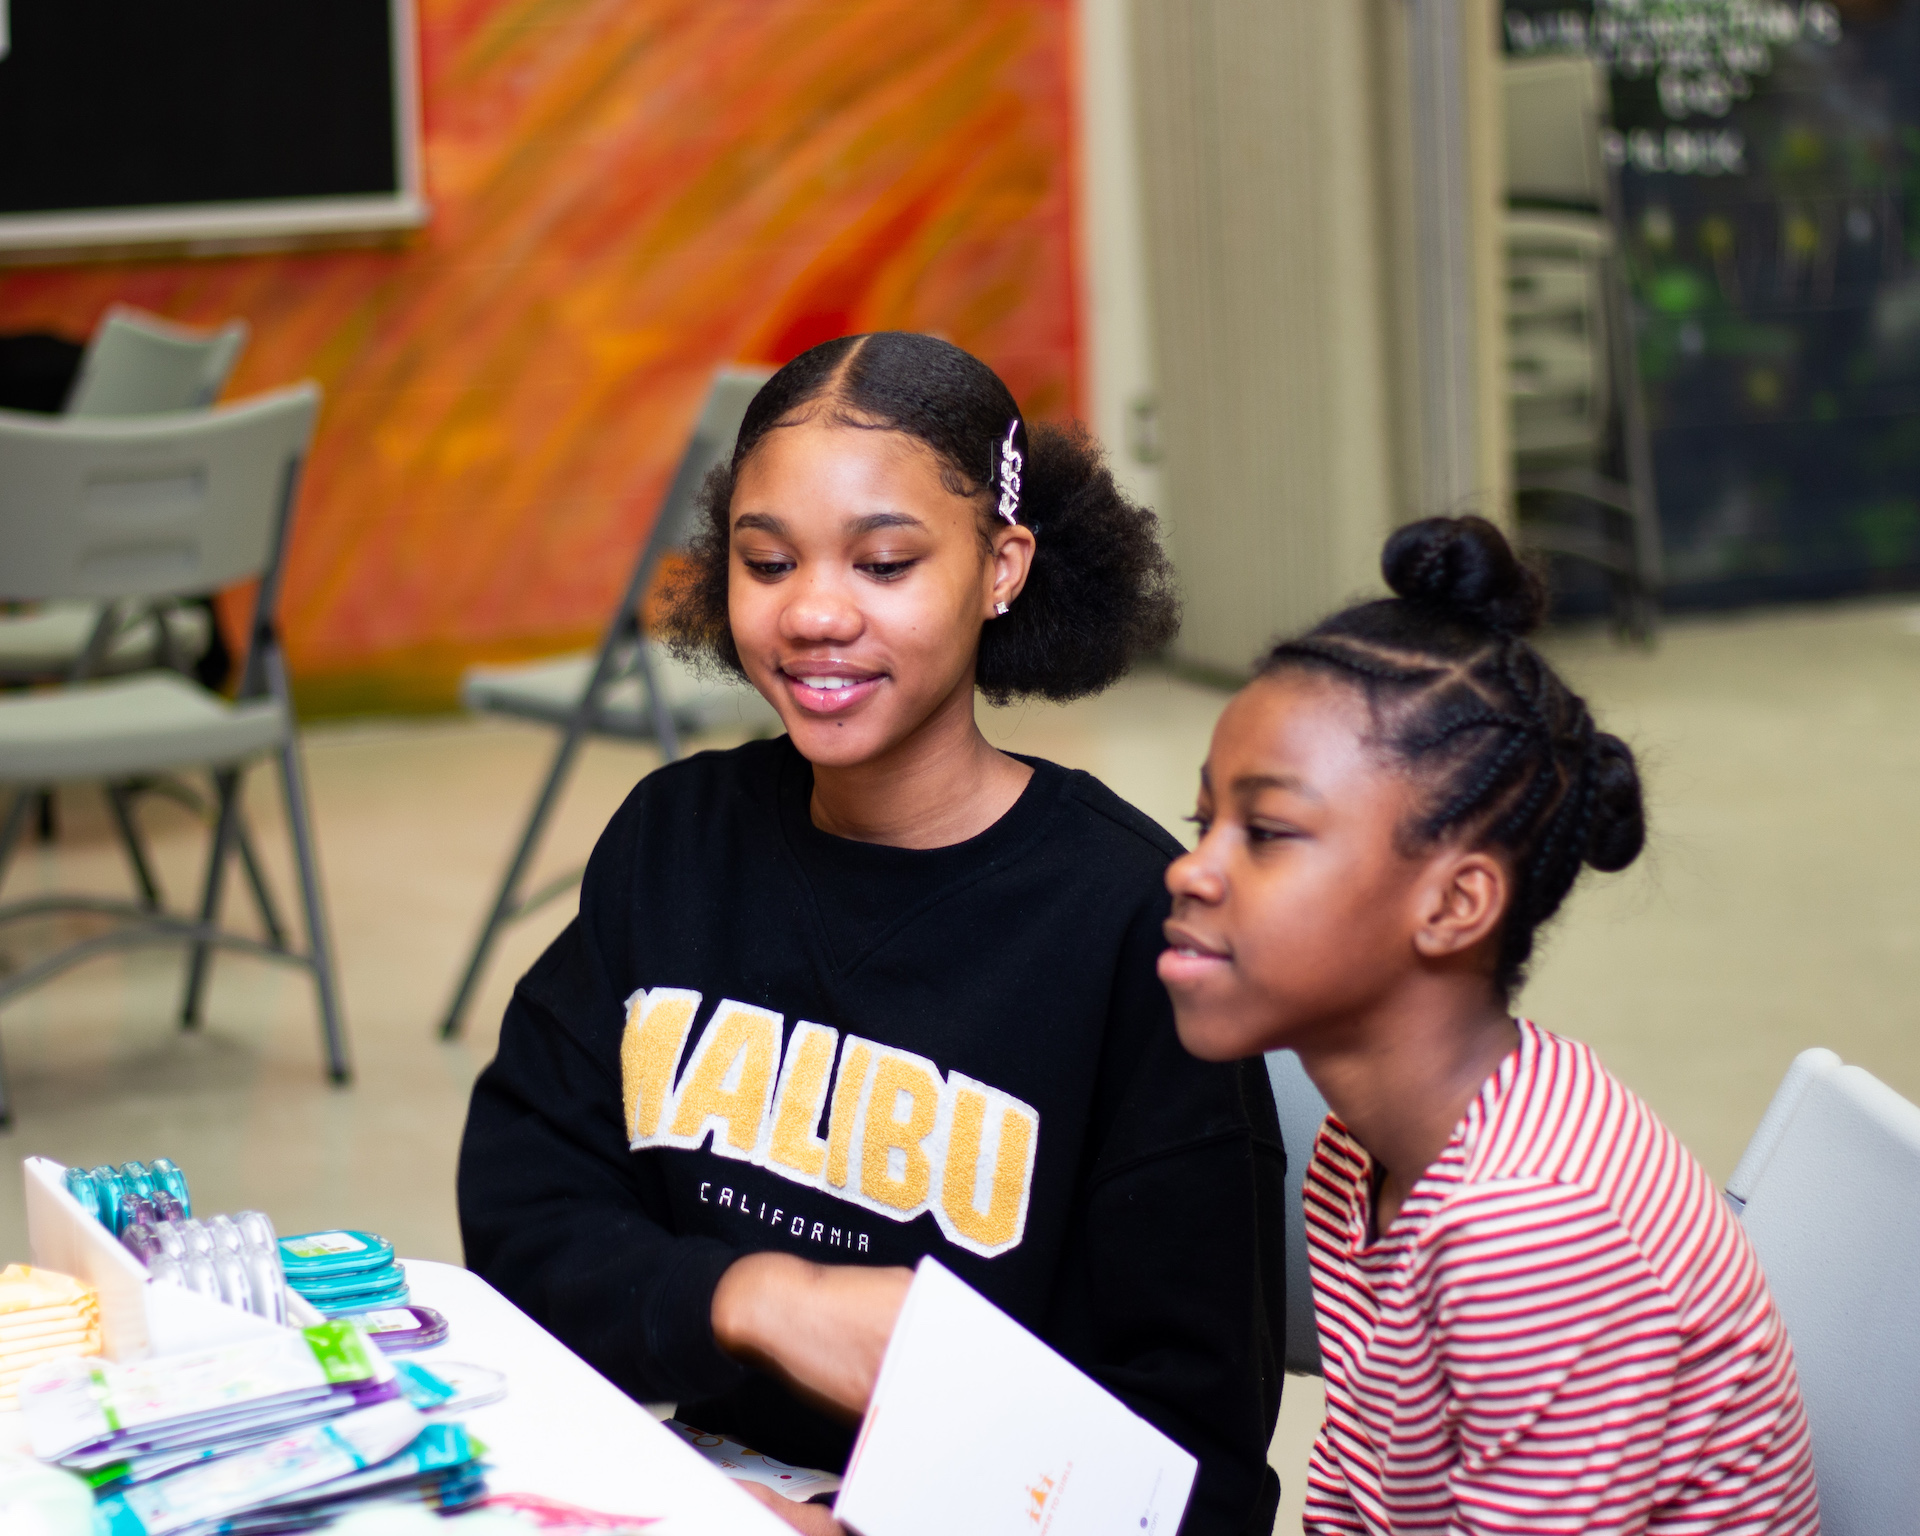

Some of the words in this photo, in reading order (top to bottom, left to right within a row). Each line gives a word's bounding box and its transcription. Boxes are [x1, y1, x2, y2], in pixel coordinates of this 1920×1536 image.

[620, 986, 1040, 1259] MALIBU
[699, 1181, 871, 1252] CALIFORNIA
[1057, 1460, 1074, 1495] GIRLS
